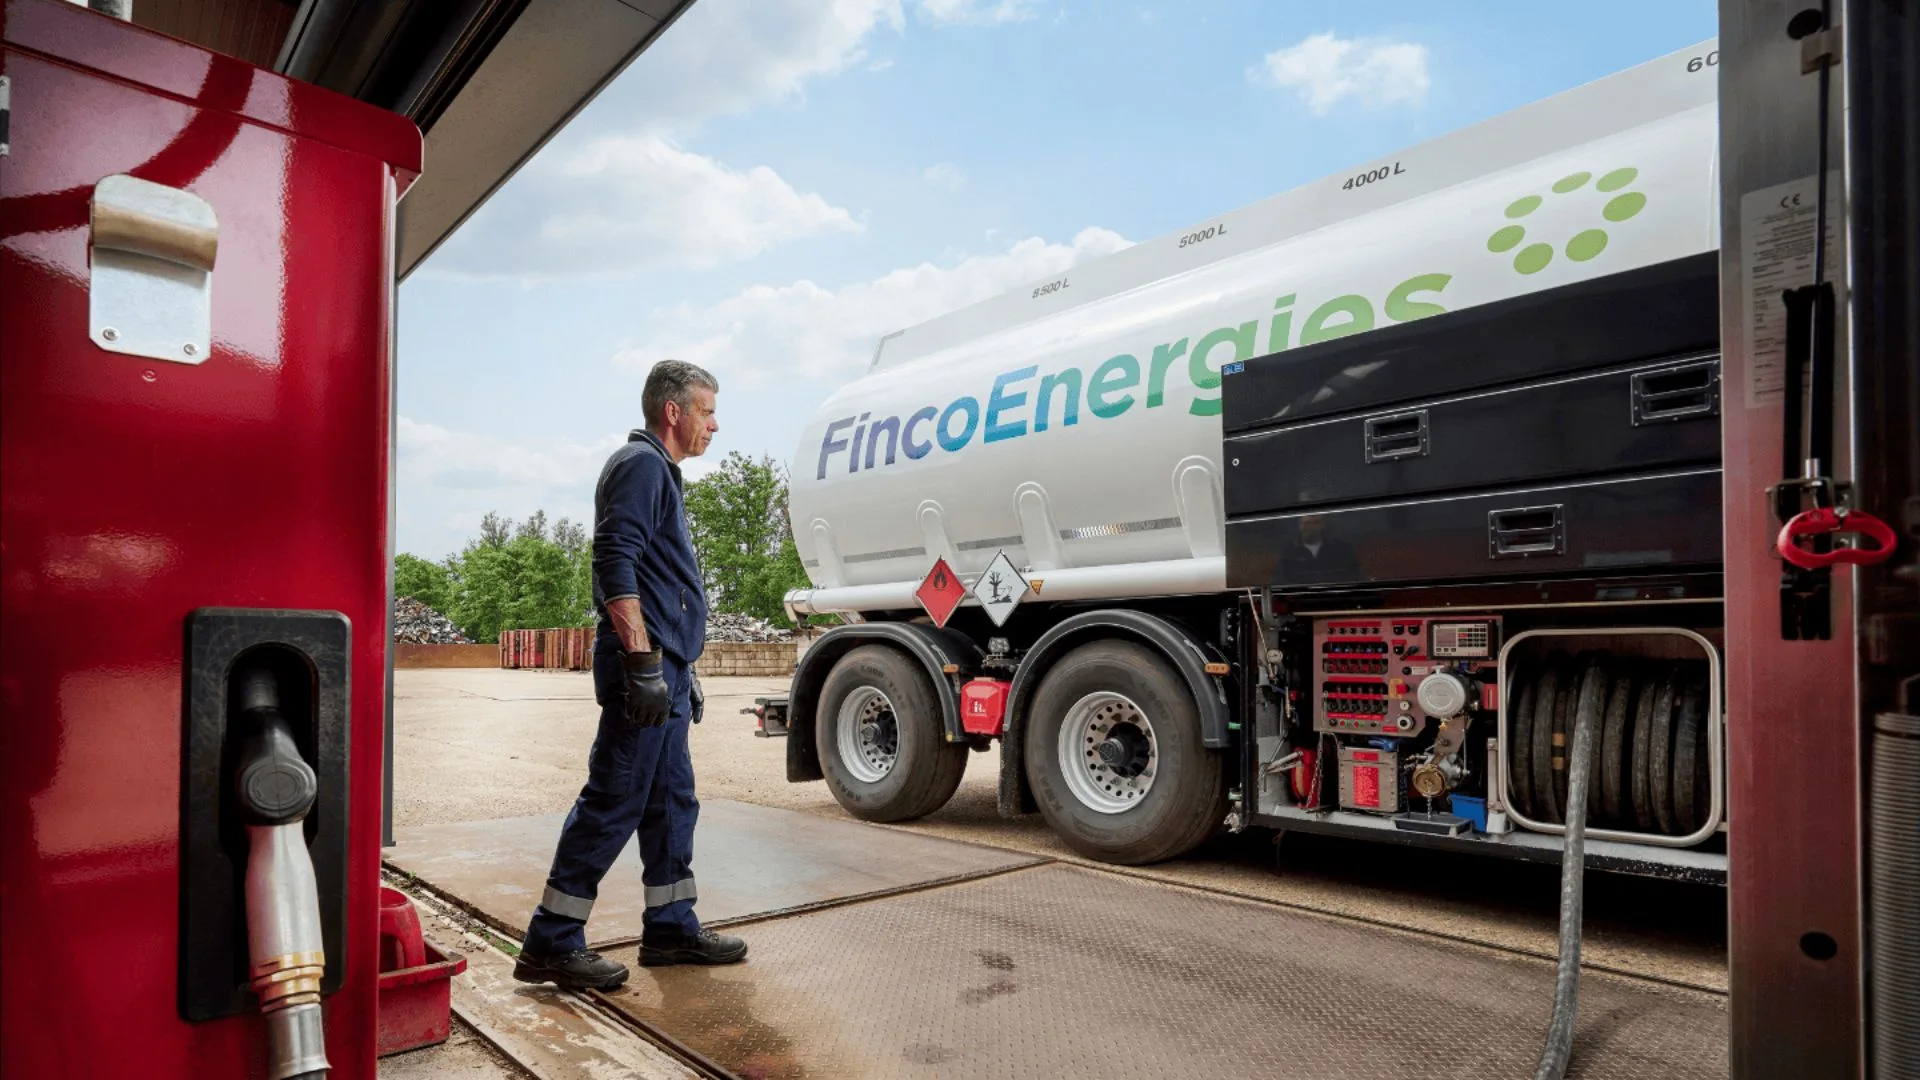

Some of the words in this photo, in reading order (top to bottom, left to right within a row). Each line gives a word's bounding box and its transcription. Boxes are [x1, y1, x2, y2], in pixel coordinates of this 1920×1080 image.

[1342, 166, 1389, 190] 4000
[1394, 161, 1406, 175] L
[1179, 227, 1216, 248] 5000
[1218, 223, 1228, 236] L
[1032, 280, 1061, 299] 8500
[1062, 277, 1071, 289] L
